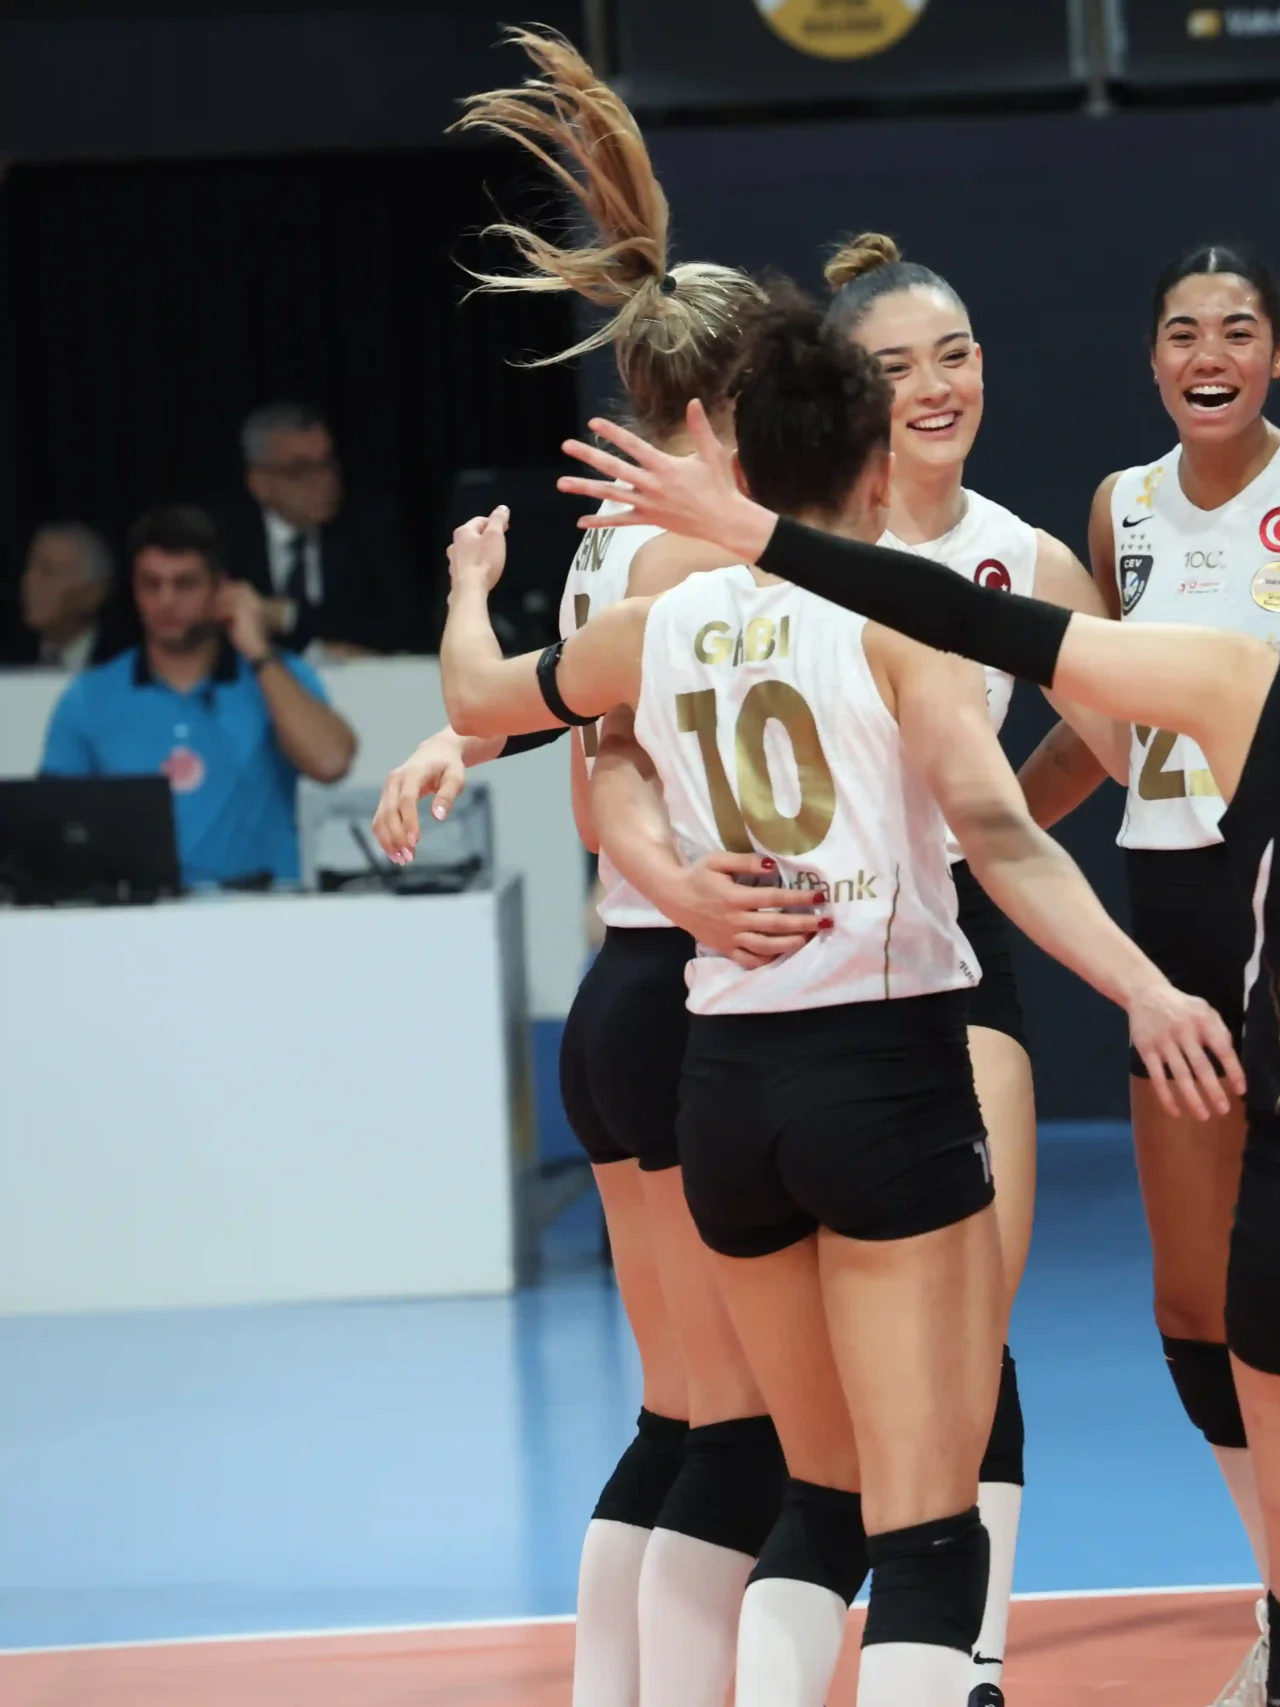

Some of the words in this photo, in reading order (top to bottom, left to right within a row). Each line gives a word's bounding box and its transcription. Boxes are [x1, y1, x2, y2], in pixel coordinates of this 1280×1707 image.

[1123, 558, 1142, 569] CEV
[694, 615, 790, 667] GABI
[675, 680, 836, 856] 10
